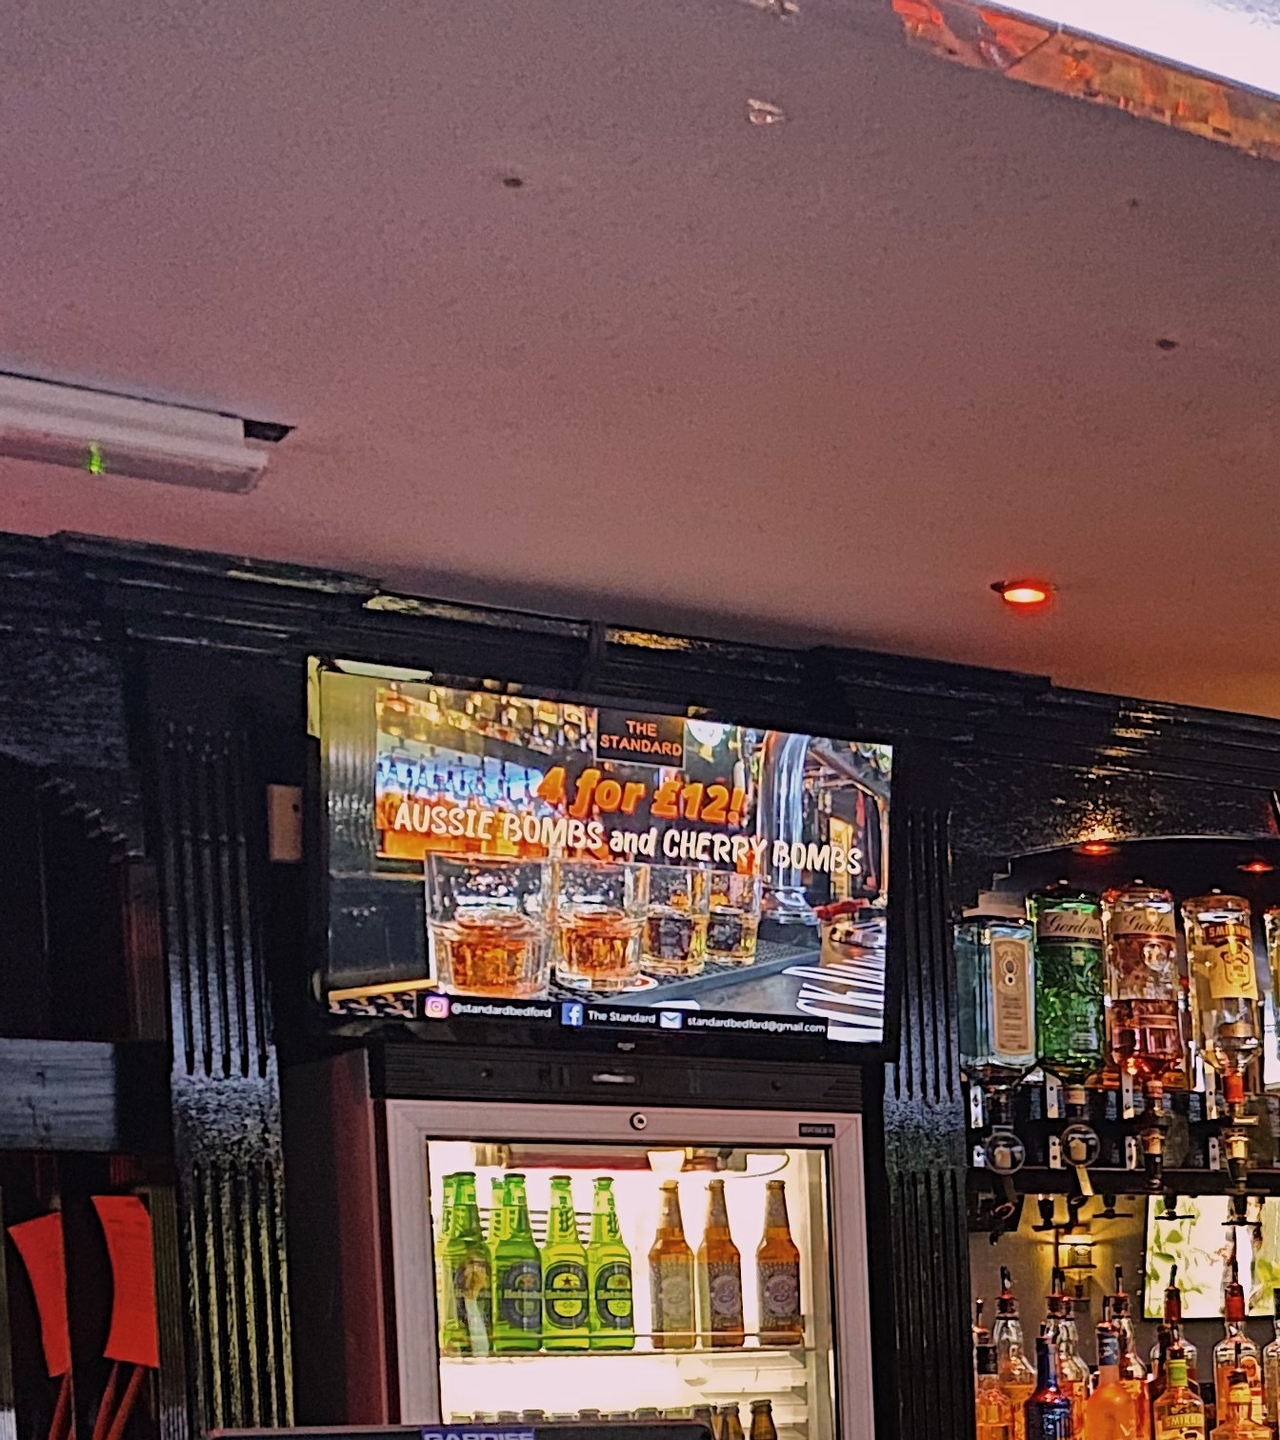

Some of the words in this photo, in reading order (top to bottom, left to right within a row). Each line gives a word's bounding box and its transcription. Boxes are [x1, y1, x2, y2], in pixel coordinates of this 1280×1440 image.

[626, 720, 657, 737] THE
[599, 734, 682, 757] STANDARD
[537, 766, 567, 805] 4
[569, 768, 646, 818] for
[651, 780, 746, 824] £12!
[394, 802, 493, 840] AUSSIE
[503, 812, 604, 849] BOMBS
[609, 828, 657, 857] and
[663, 829, 768, 866] CHERRY
[772, 839, 862, 875] BOMBS
[451, 1002, 551, 1018] @standardbedford
[588, 1009, 608, 1022] The
[609, 1011, 656, 1024] Standard
[687, 1017, 827, 1033] standardbedford@gmail.com
